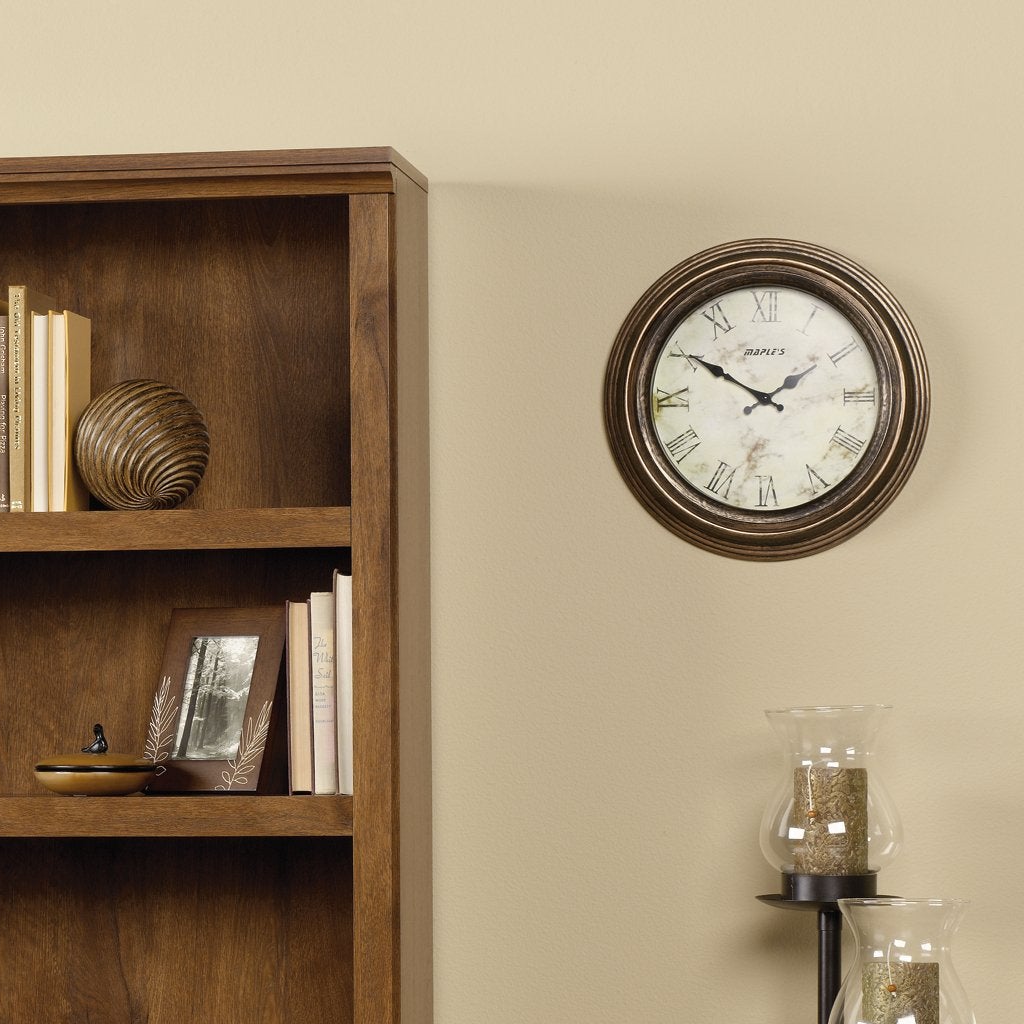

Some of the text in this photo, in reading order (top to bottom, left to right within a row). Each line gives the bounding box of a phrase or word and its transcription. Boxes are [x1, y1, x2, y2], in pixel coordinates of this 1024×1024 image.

[700, 300, 736, 341] XI
[751, 290, 782, 322] XII
[743, 348, 785, 356] MAPLE'S
[826, 336, 862, 368] II
[656, 386, 690, 413] IX
[843, 387, 875, 407] III
[664, 425, 702, 464] VIII
[704, 460, 737, 500] VII
[754, 475, 780, 507] VI
[805, 464, 831, 495] V
